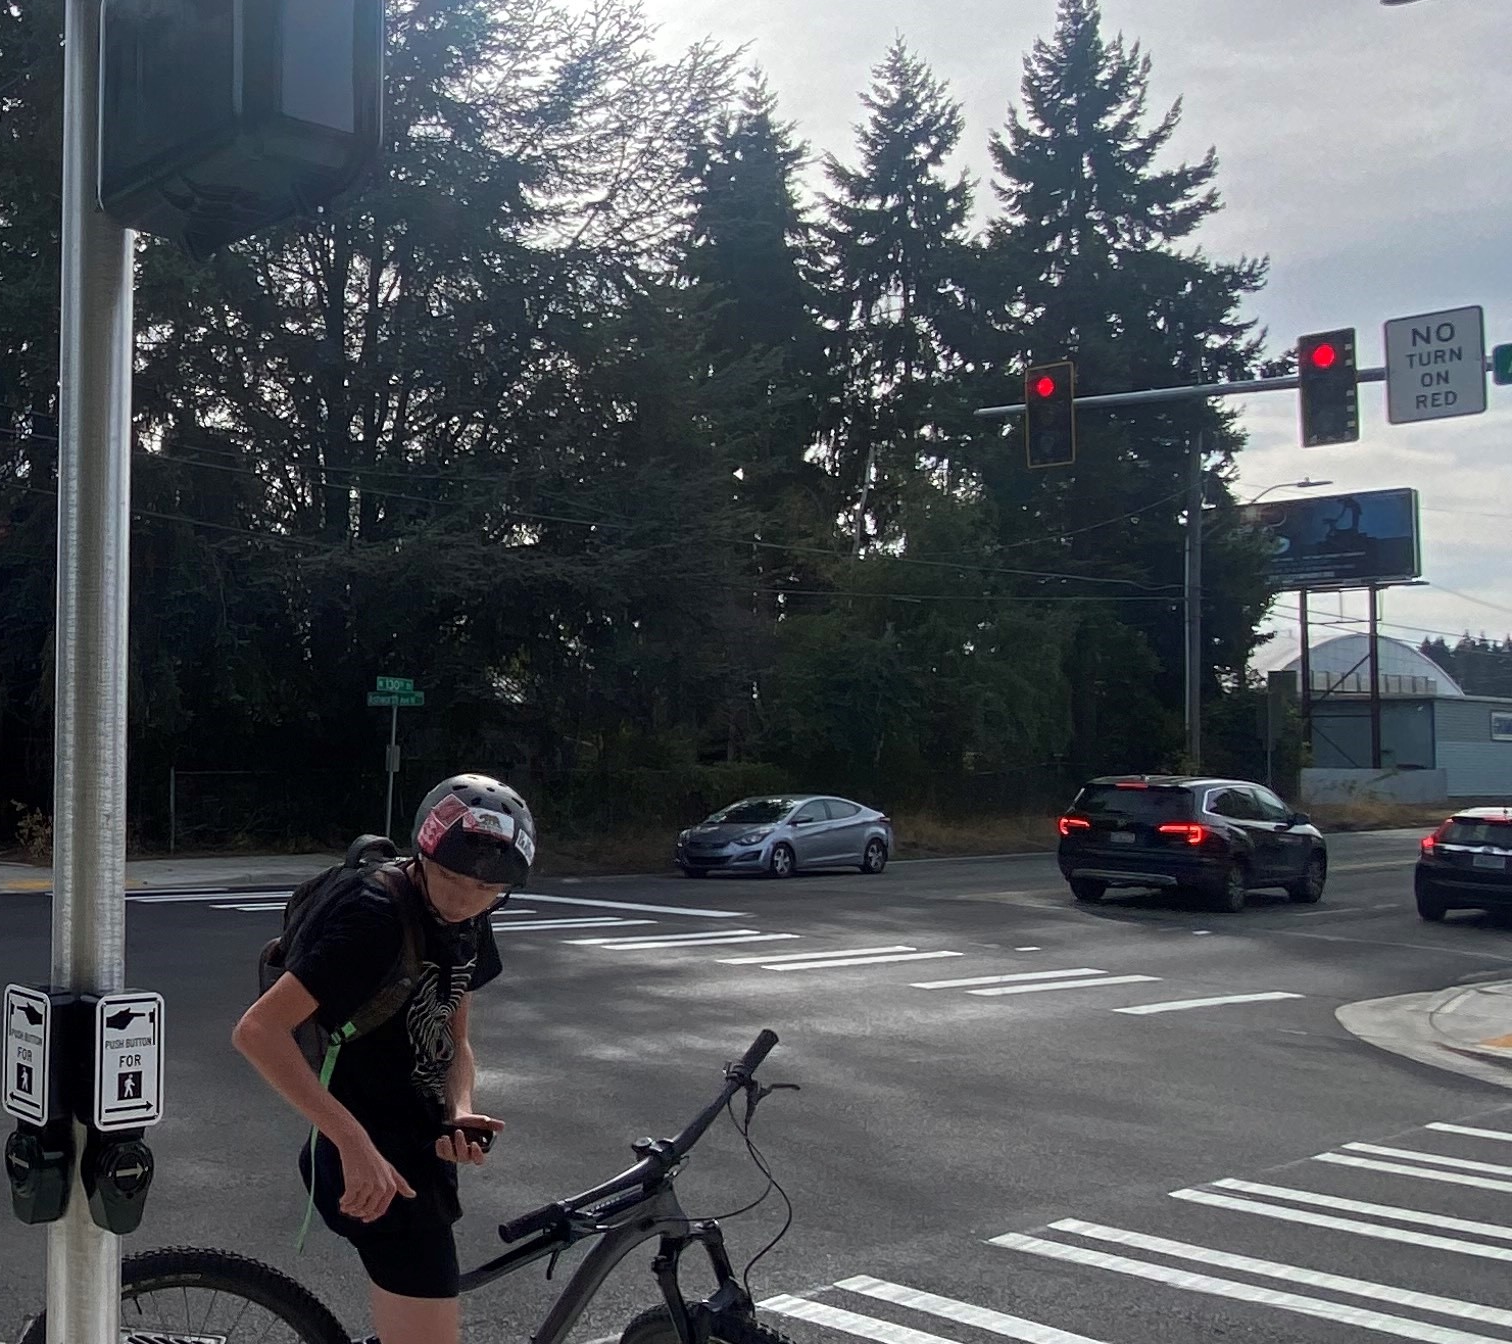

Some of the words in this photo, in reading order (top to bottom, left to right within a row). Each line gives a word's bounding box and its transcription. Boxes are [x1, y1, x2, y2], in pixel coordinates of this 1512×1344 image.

[1411, 322, 1456, 347] NO
[1405, 346, 1463, 369] TURN
[1420, 370, 1450, 388] ON
[1415, 390, 1458, 410] RED
[105, 1039, 125, 1050] PUSH
[125, 1036, 152, 1048] BUTTON
[17, 1046, 33, 1063] FOR
[118, 1054, 142, 1068] FOR
